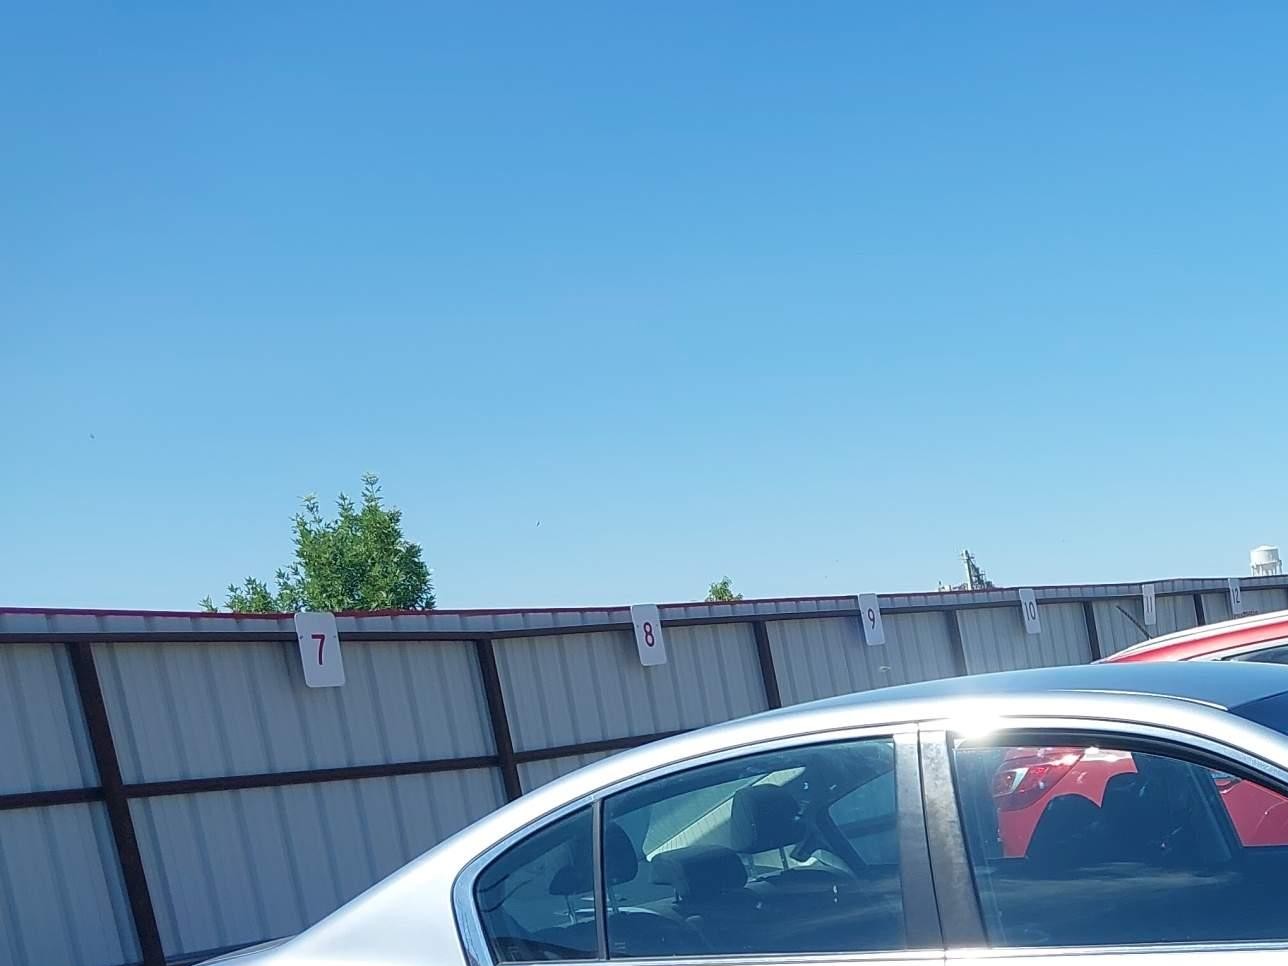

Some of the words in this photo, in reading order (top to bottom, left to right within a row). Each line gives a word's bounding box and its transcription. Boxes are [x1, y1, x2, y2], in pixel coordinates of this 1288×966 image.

[1145, 595, 1153, 614] 11
[1231, 588, 1241, 605] 12
[867, 608, 876, 629] 9
[1024, 598, 1037, 621] 10
[643, 622, 656, 648] 8
[311, 633, 326, 665] 7
